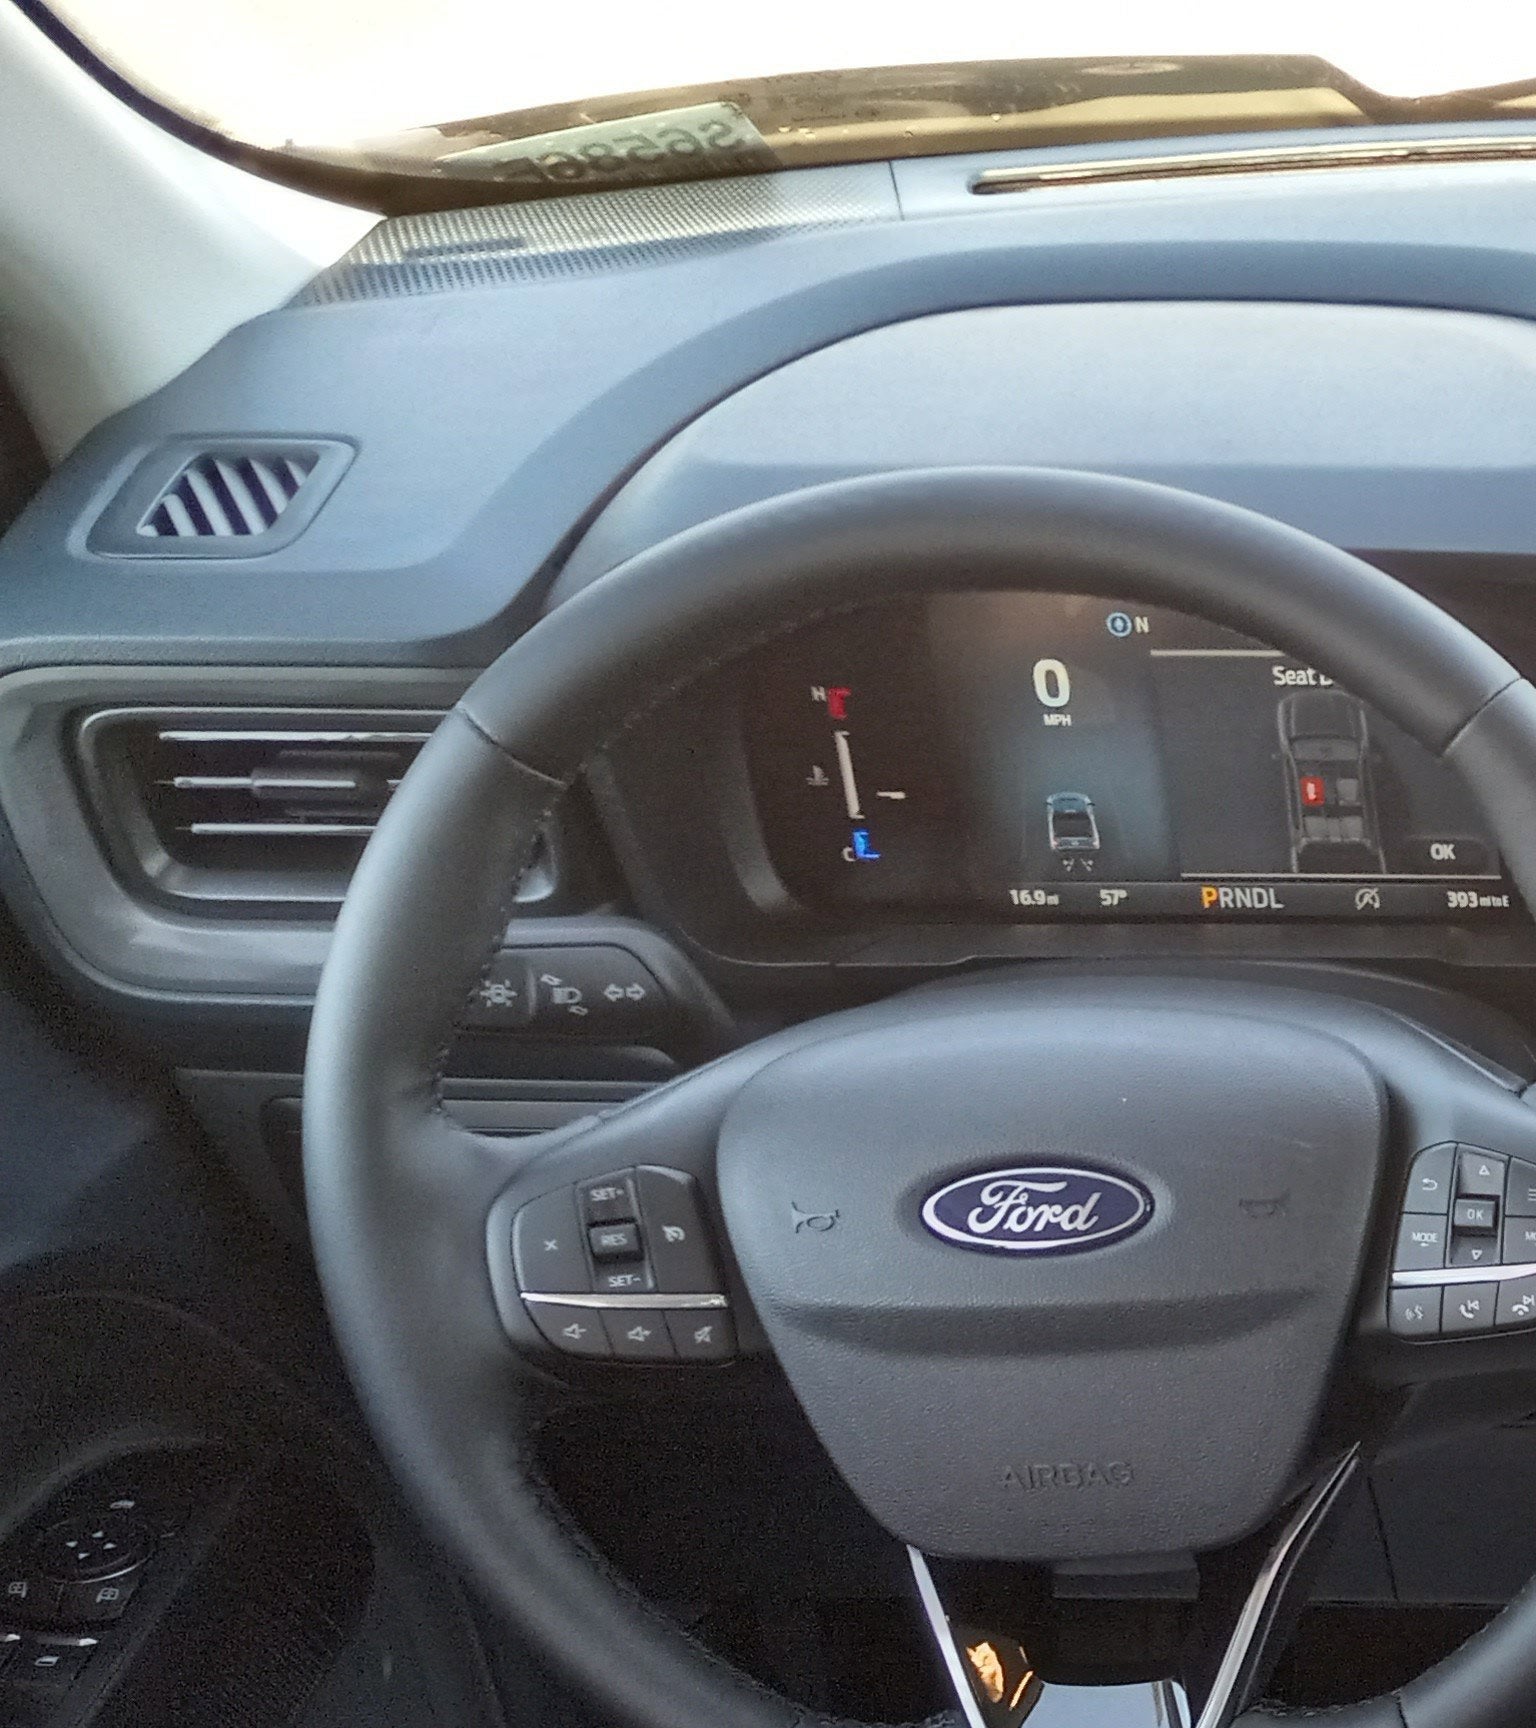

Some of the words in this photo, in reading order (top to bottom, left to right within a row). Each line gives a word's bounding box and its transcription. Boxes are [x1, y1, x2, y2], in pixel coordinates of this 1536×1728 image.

[1135, 617, 1149, 632] N
[1032, 658, 1071, 708] 0
[1272, 666, 1317, 686] Seat
[1043, 713, 1072, 727] MPH
[1430, 843, 1455, 860] OK
[1447, 891, 1478, 907] 393
[967, 1180, 1102, 1234] Ford
[1466, 1208, 1484, 1221] OK
[601, 1233, 627, 1246] RES
[1412, 1231, 1438, 1243] MODE
[1002, 1460, 1135, 1489] AIRBAG
